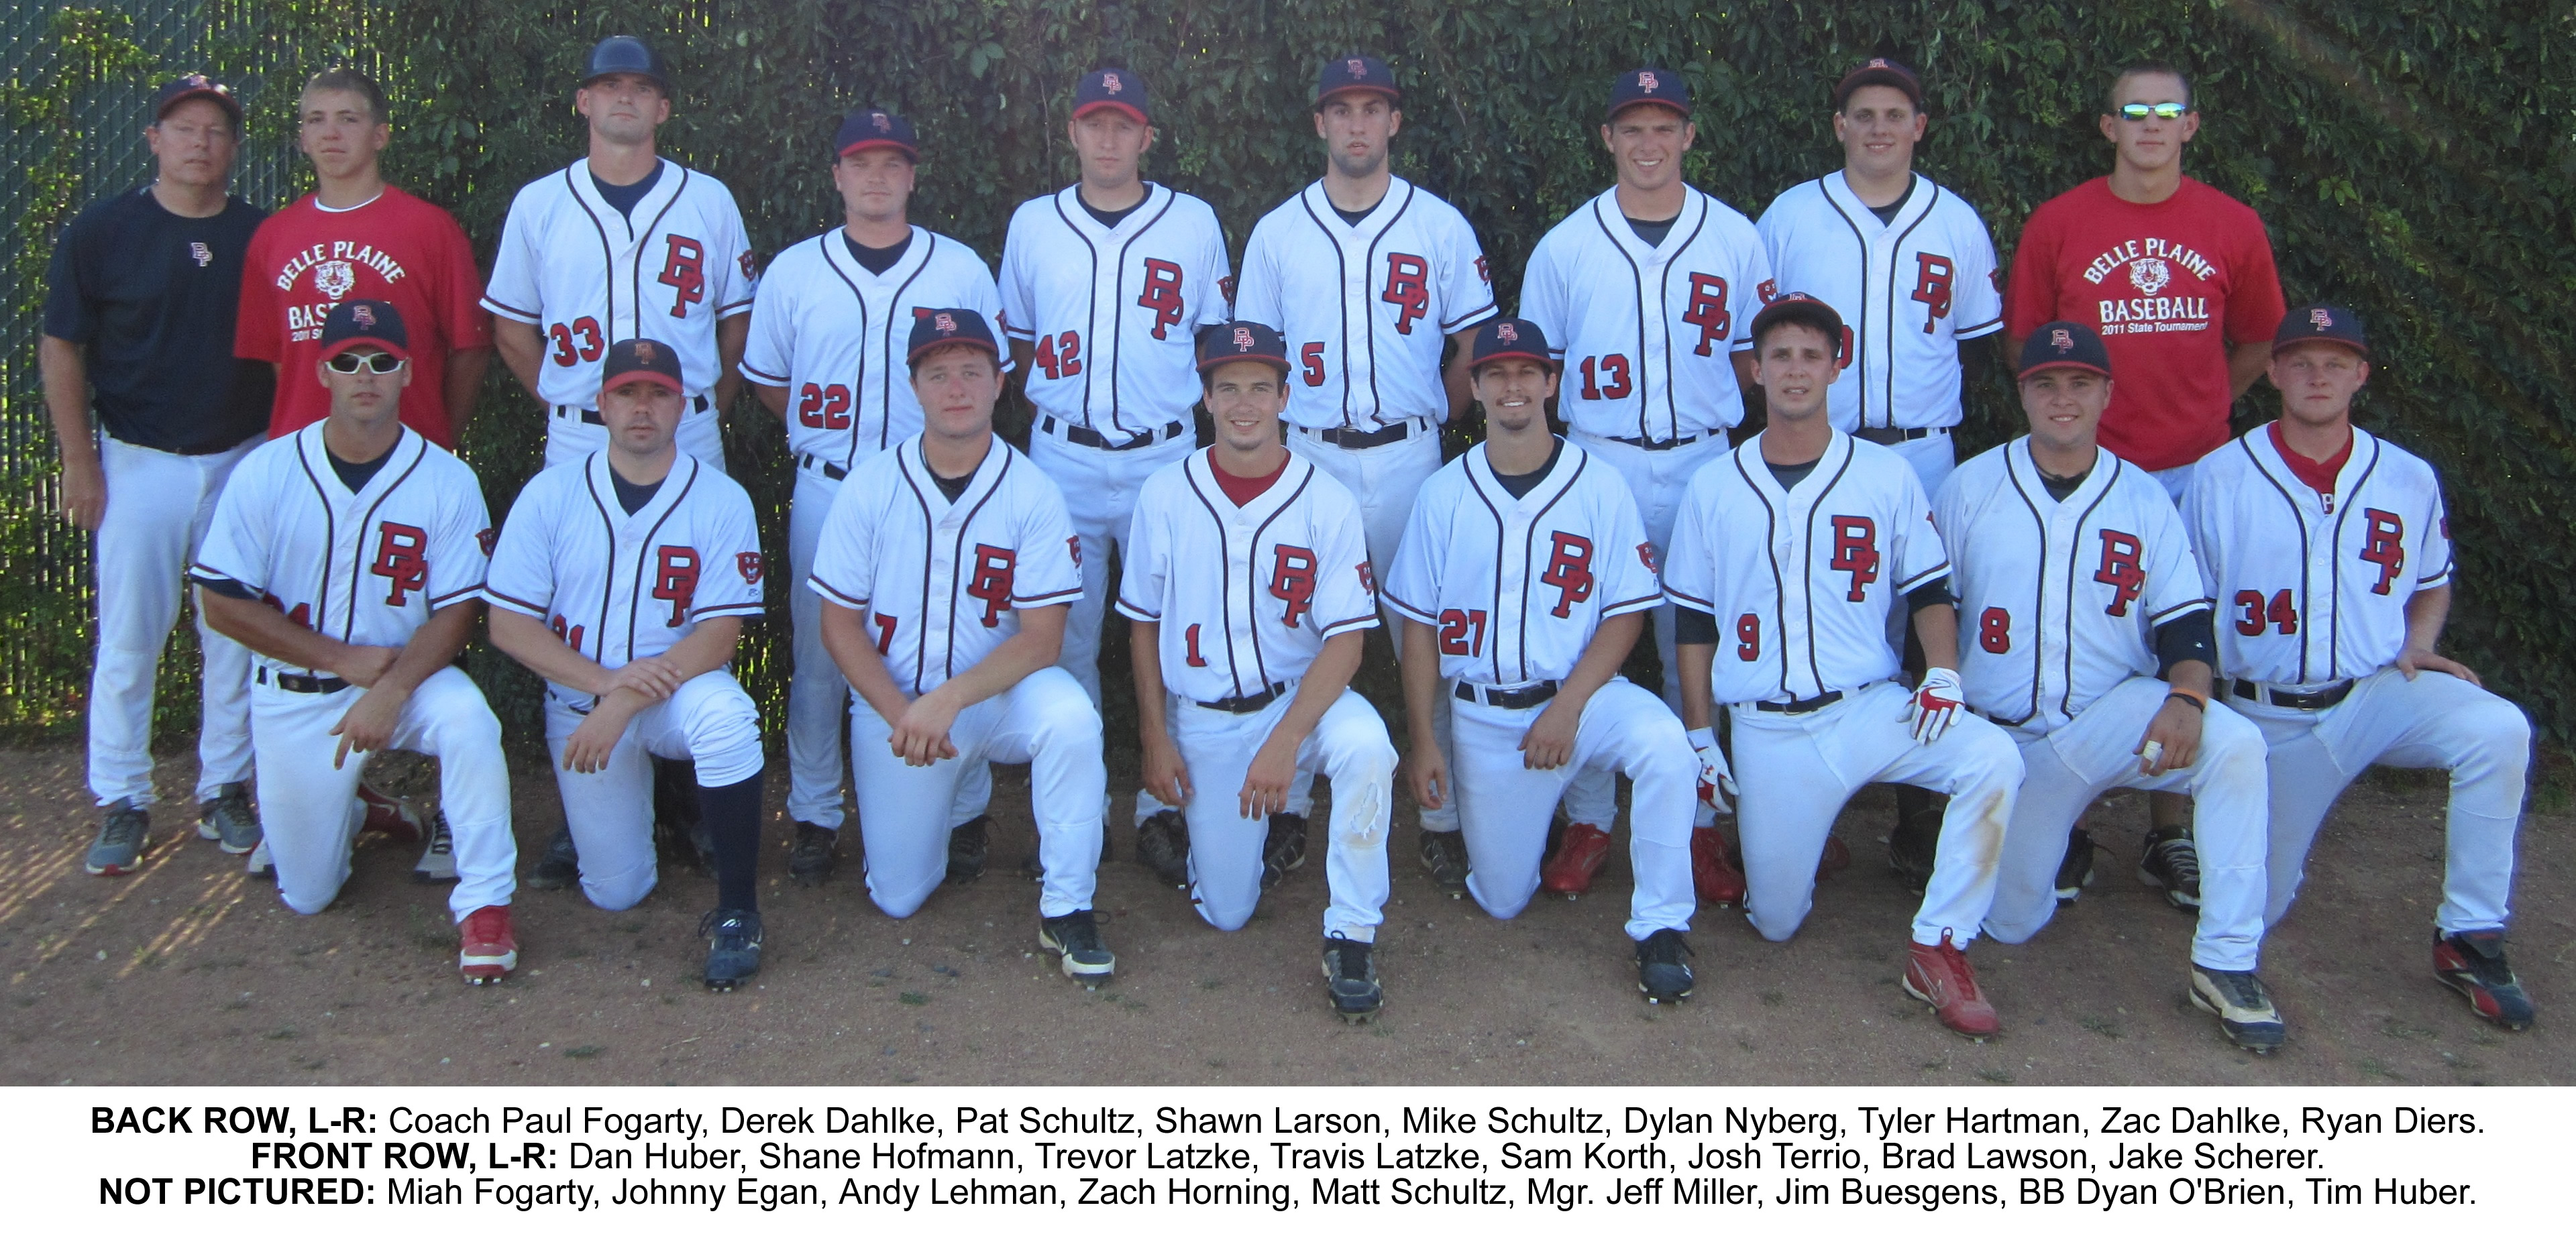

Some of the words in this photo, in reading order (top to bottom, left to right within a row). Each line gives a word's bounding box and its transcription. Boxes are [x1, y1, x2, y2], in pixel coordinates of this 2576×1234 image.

[191, 243, 213, 266] BP
[277, 243, 327, 291] BELLE
[333, 241, 405, 284] PLAINE
[658, 233, 705, 319] BP
[2083, 240, 2139, 284] BELLE
[2145, 238, 2216, 281] PLAINE
[1138, 257, 1183, 341] BP
[1382, 252, 1429, 335] BP
[1682, 272, 1731, 357] BP
[1911, 251, 1953, 334] BP
[2099, 297, 2208, 323] BASEBALL
[550, 315, 603, 367] 33
[1233, 327, 1254, 351] BP
[2102, 323, 2124, 335] 2011
[2127, 323, 2153, 333] State
[2154, 321, 2208, 333] Tournament
[1035, 330, 1082, 380] 42
[1301, 342, 1326, 387] 5
[1580, 353, 1632, 400] 13
[799, 382, 851, 430] 22
[372, 521, 428, 607] BP
[1541, 530, 1594, 619] BP
[1831, 515, 1880, 602] BP
[2094, 528, 2145, 617] BP
[2359, 508, 2404, 596] BP
[967, 543, 1016, 628] BP
[1269, 544, 1317, 628] BP
[875, 612, 898, 655] 7
[1439, 609, 1487, 658] 27
[1737, 614, 1760, 661] 9
[1980, 606, 2011, 654] 8
[2235, 589, 2297, 636] 34
[1186, 624, 1207, 667] 1
